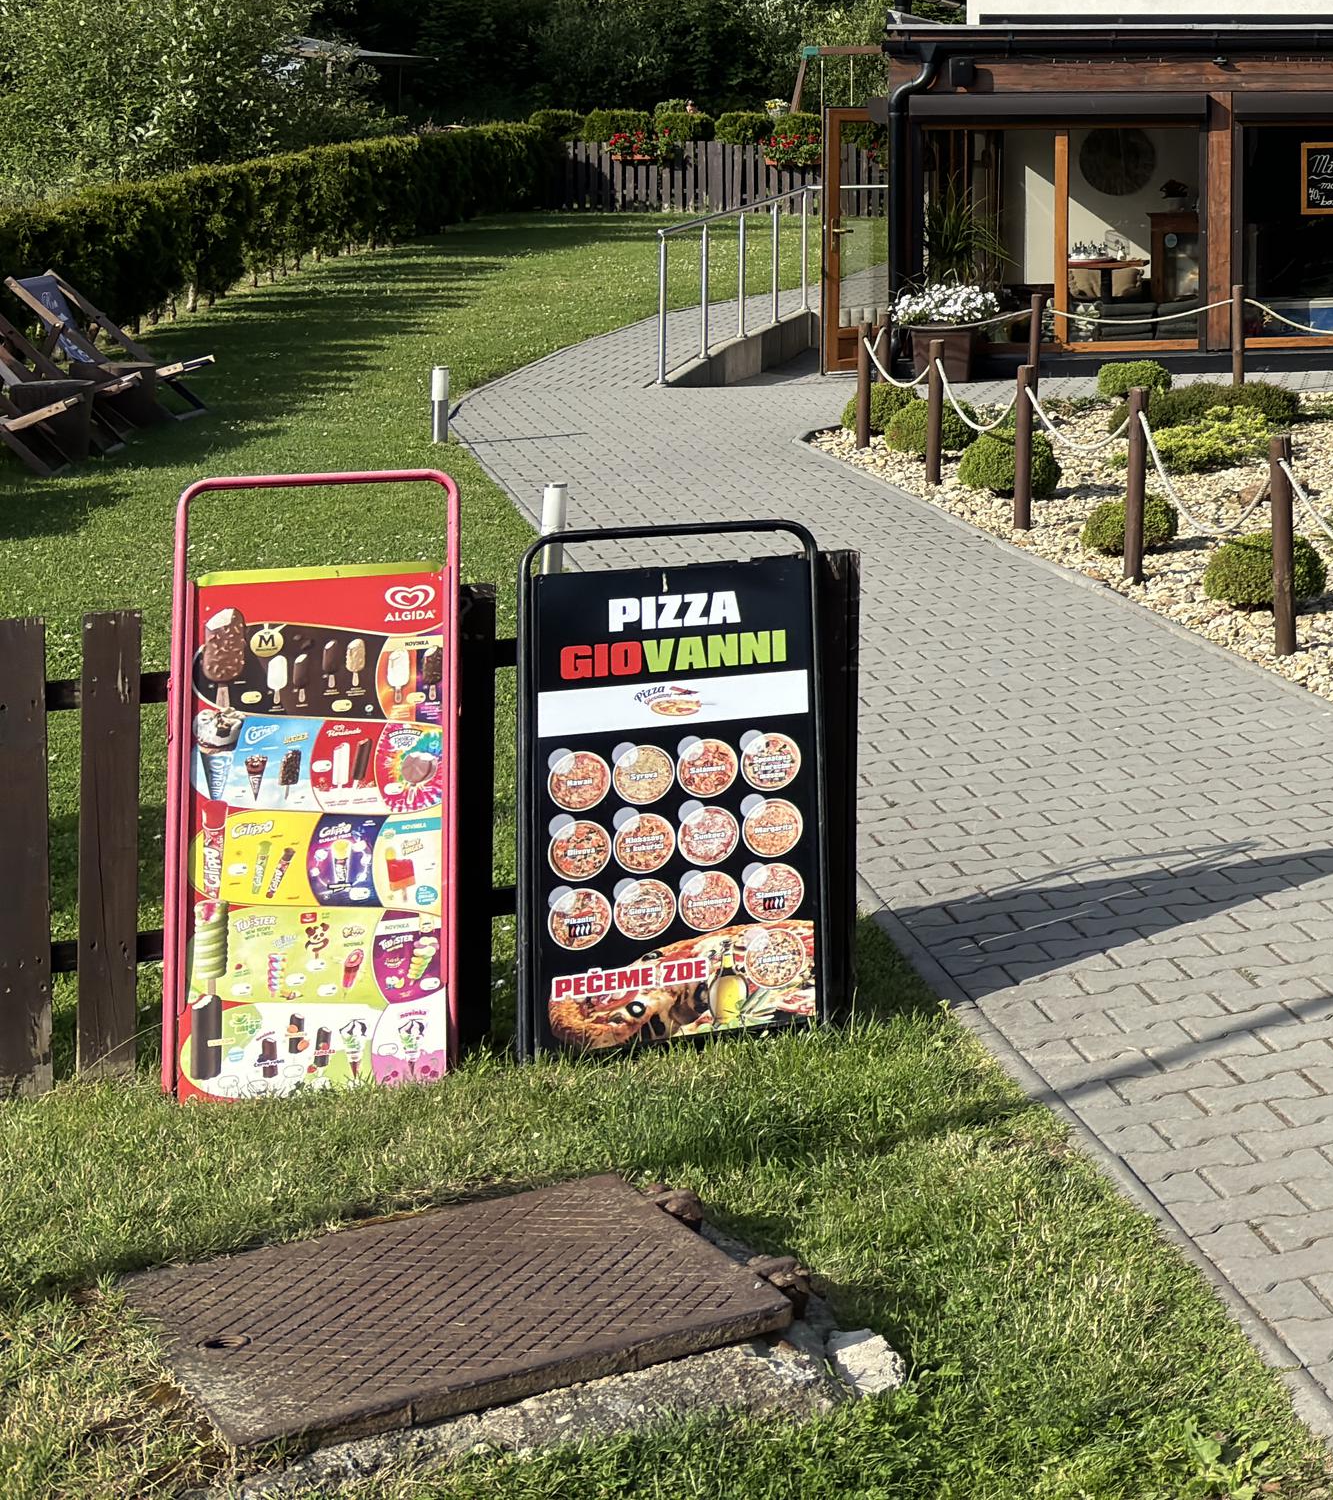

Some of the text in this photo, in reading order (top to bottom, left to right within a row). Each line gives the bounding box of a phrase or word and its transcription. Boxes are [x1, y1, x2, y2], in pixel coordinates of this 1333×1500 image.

[384, 610, 434, 622] ALGIDA
[608, 590, 741, 632] PIZZA
[560, 629, 787, 680] GIOVANNI
[634, 686, 665, 702] Pizza
[566, 778, 593, 787] Hawaii
[629, 771, 658, 781] Syrová
[231, 820, 274, 839] Calippo
[553, 958, 707, 999] PEČEME ZDE
